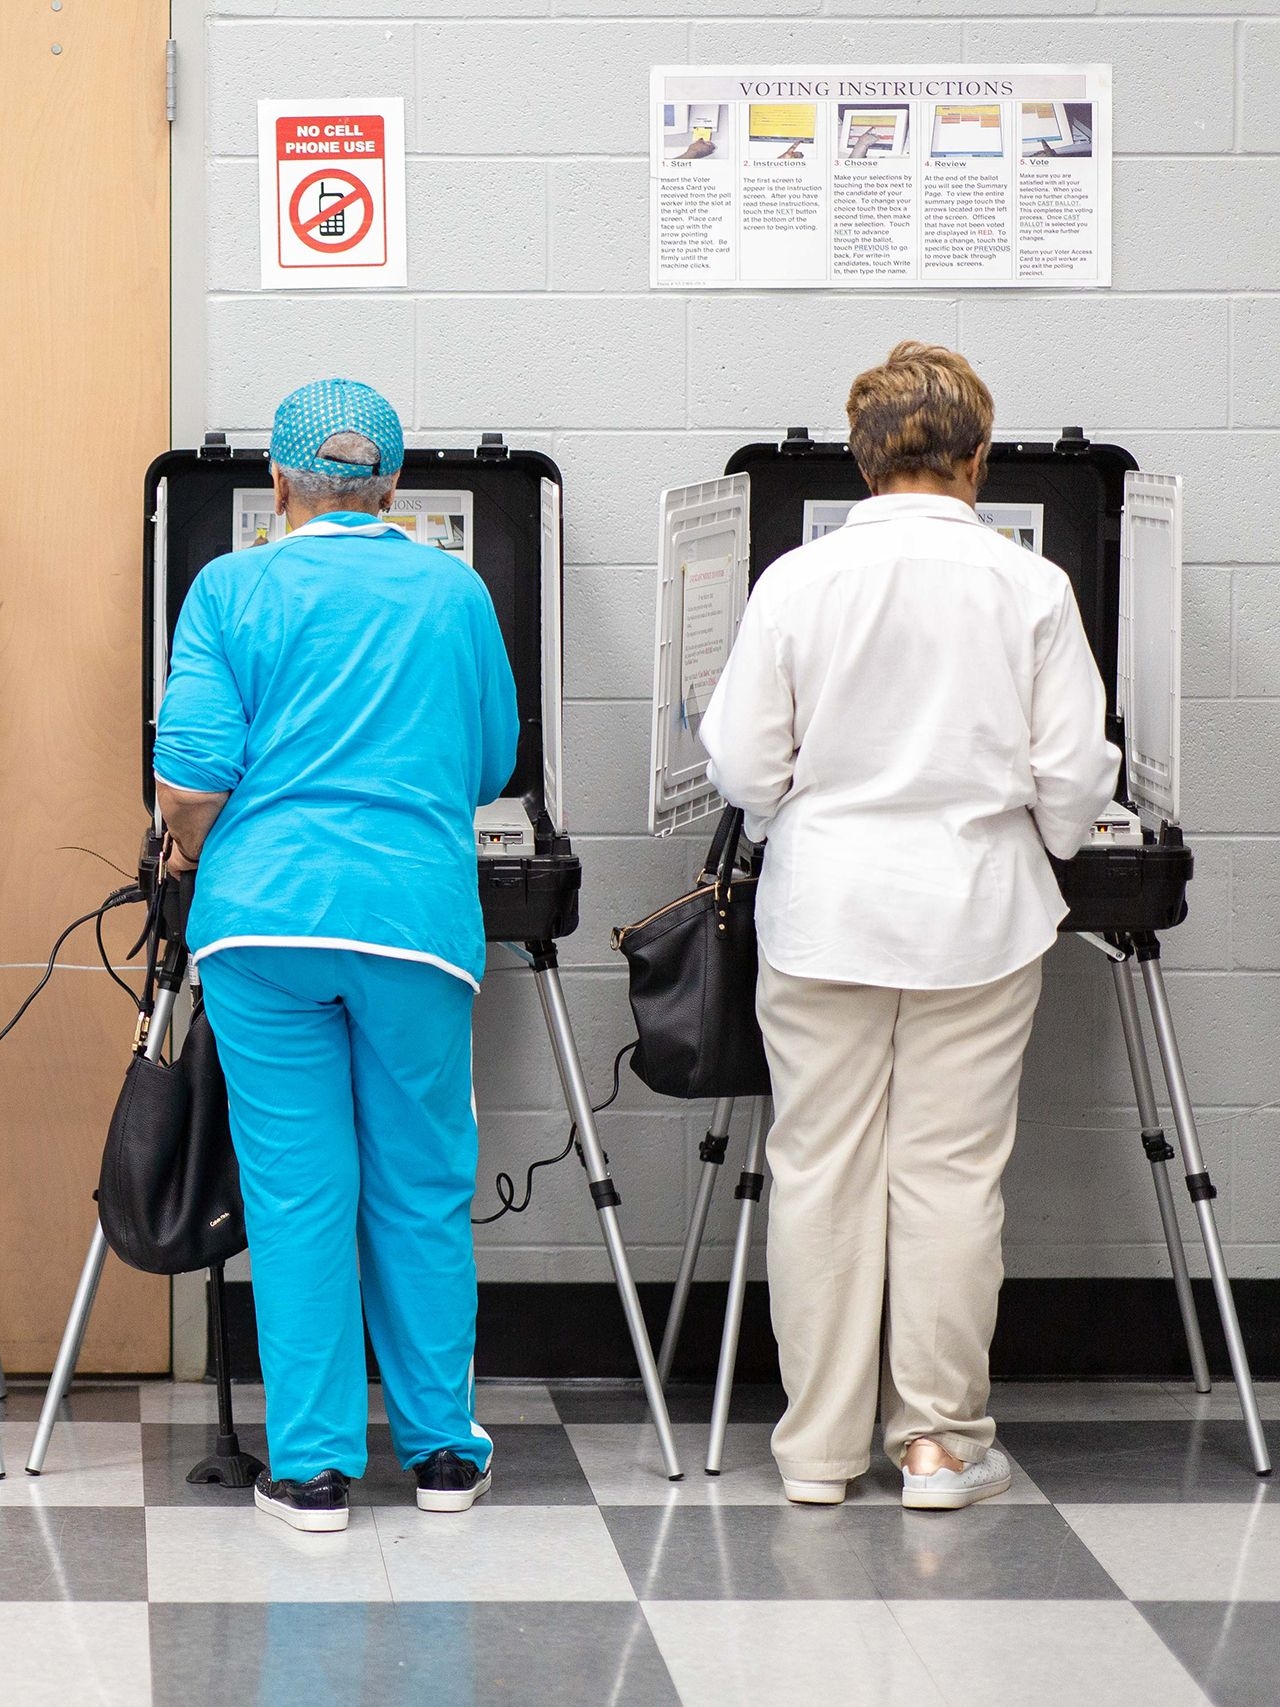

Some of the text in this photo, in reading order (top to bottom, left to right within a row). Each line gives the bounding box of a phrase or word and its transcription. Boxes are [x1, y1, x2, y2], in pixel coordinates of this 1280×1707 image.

[740, 81, 1013, 96] VOTING INSTRUCTIONS
[296, 124, 364, 138] NO CELL
[285, 140, 376, 154] PHONE USE
